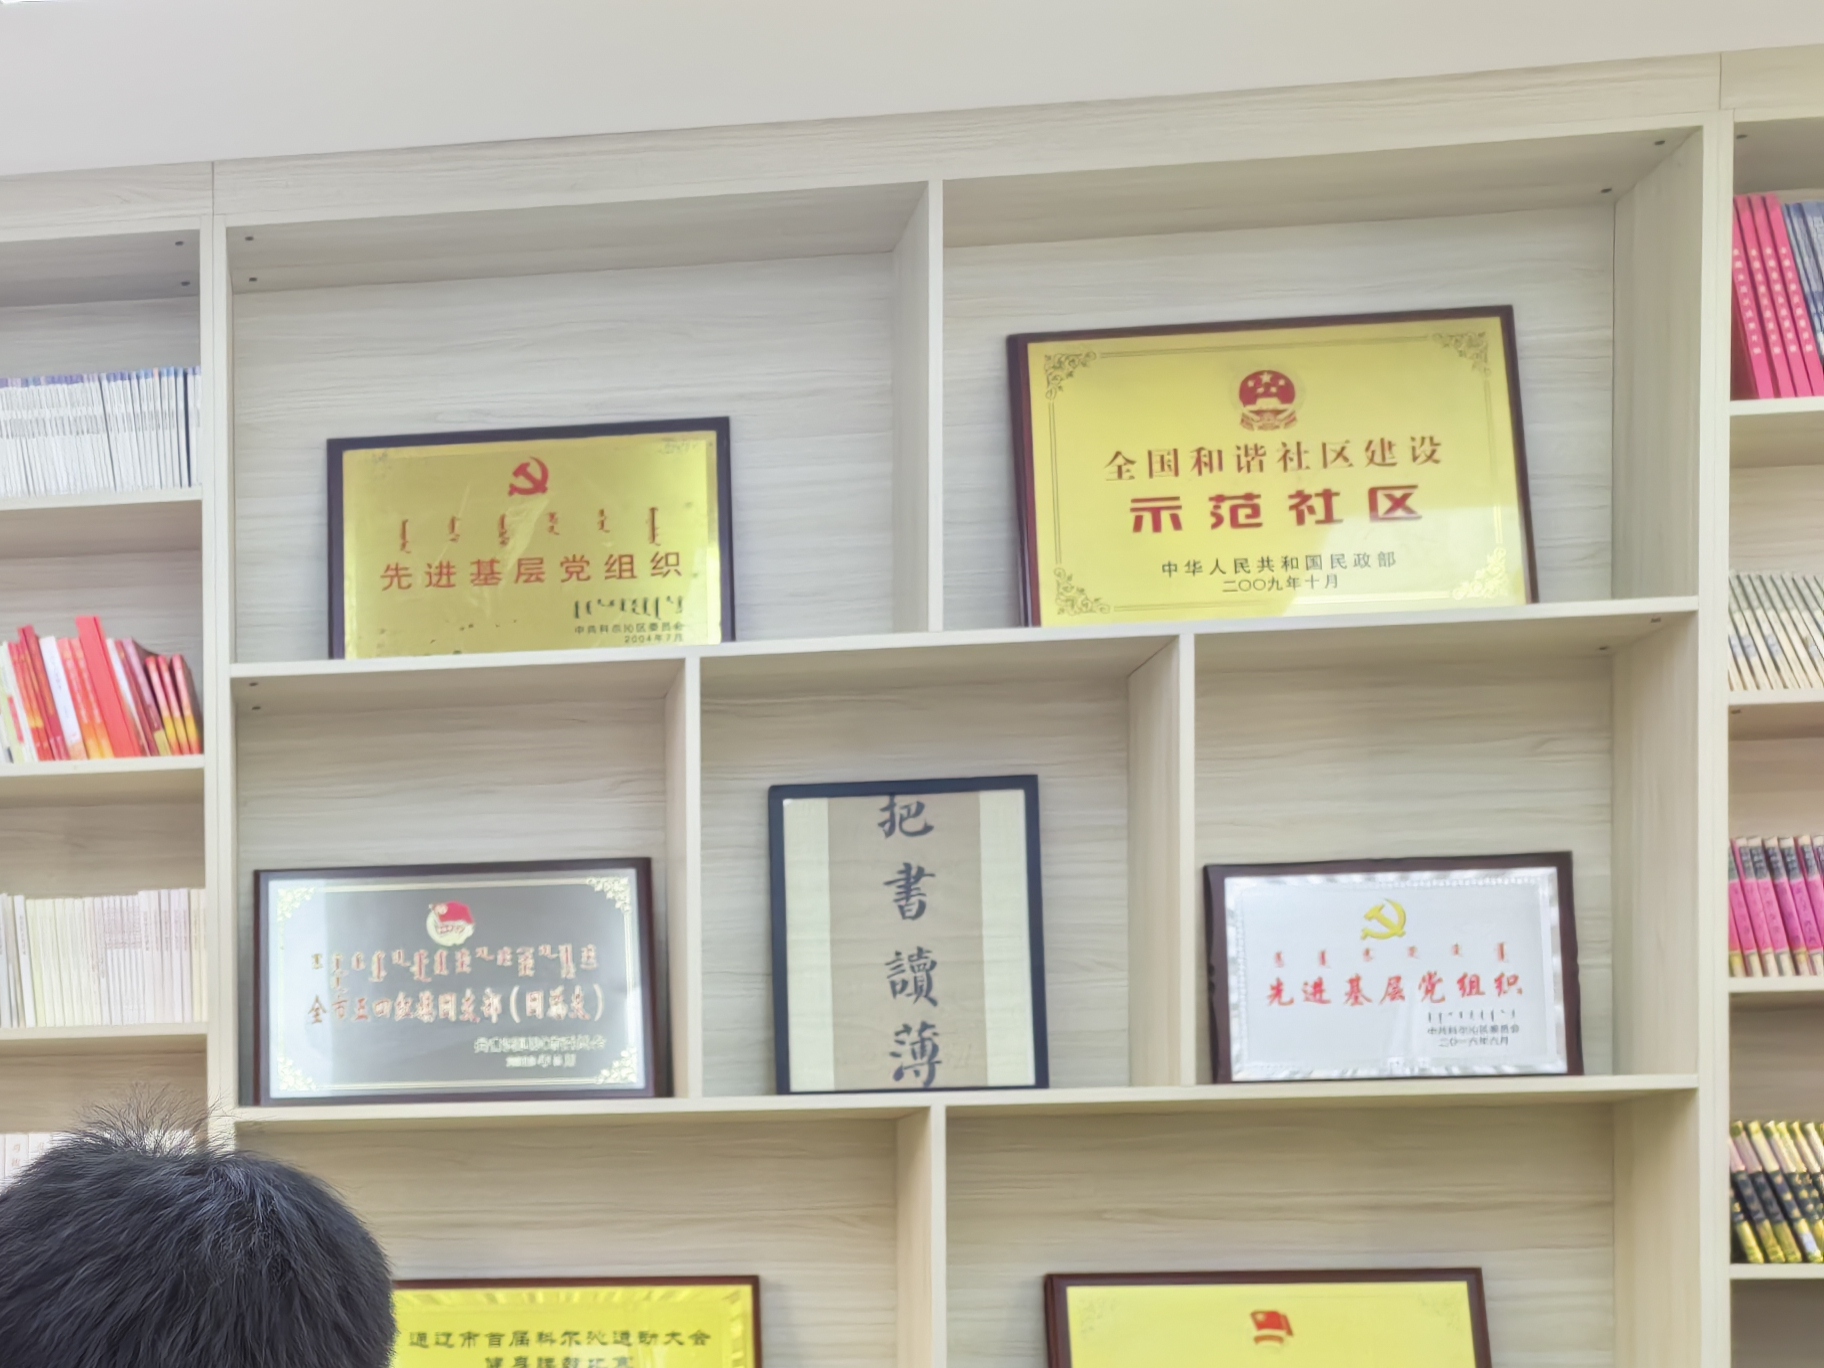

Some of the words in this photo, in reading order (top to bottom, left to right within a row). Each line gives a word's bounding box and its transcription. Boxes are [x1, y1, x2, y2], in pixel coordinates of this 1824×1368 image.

[1104, 435, 1444, 482] 全国和谐社区建设
[1130, 483, 1423, 534] 示范社区
[380, 551, 682, 591] 先进基层党组织
[1161, 550, 1397, 579] 中华人民共和国民政部
[1267, 970, 1524, 1007] 先进基层党组织
